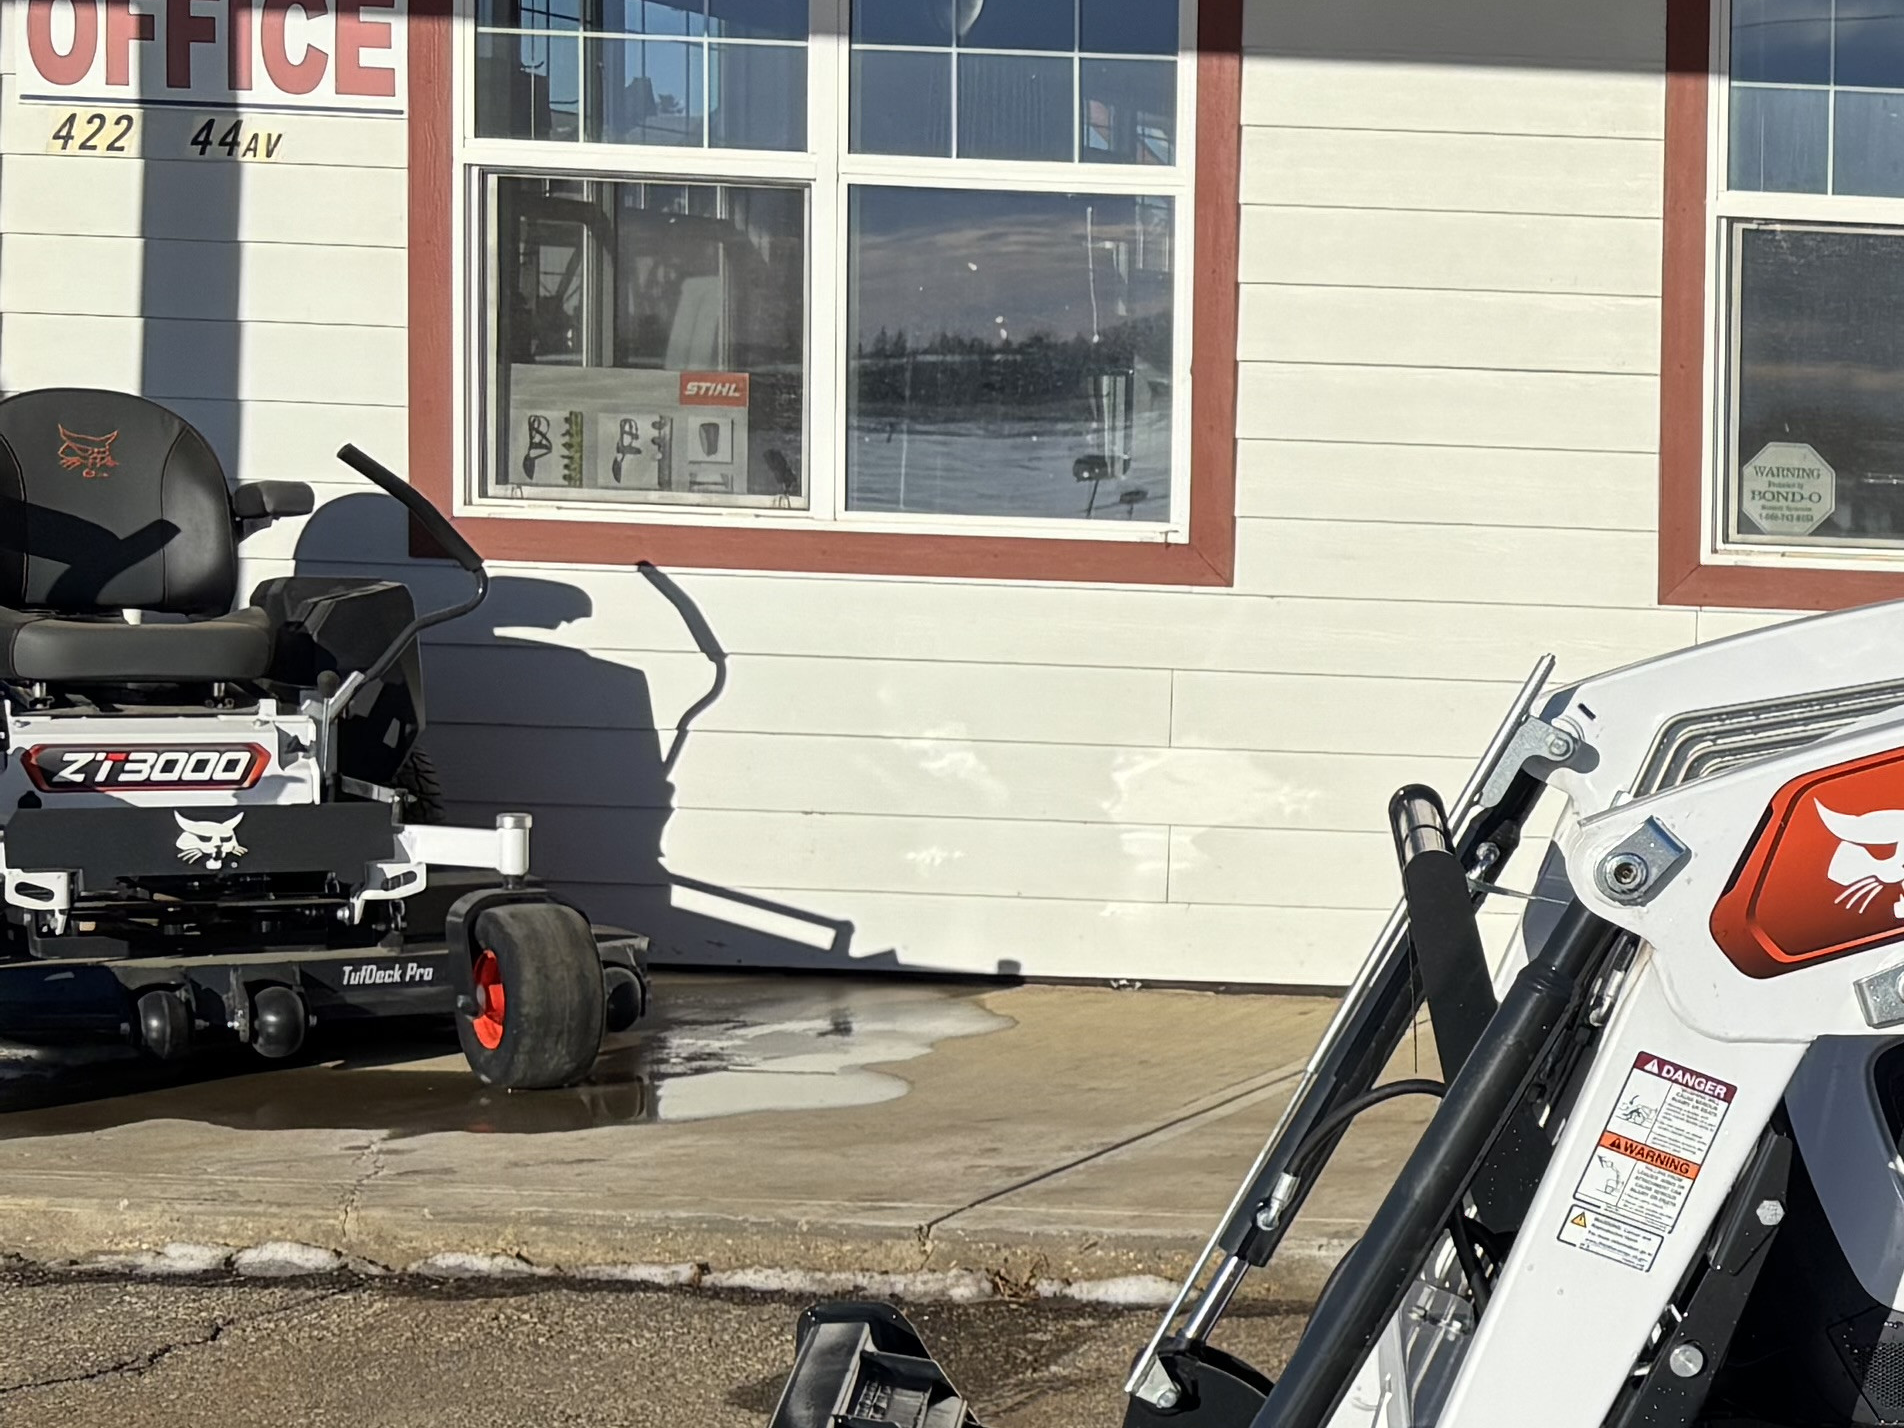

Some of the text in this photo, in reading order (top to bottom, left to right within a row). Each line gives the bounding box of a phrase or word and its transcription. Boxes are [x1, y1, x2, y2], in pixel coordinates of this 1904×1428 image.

[52, 112, 135, 152] 422
[685, 381, 741, 397] STIHL
[1754, 465, 1821, 480] WARNING
[51, 751, 252, 783] ZT3000
[342, 962, 434, 985] TufDeck Pro
[1661, 1065, 1727, 1099] DANGER
[1624, 1141, 1691, 1175] WARNING
